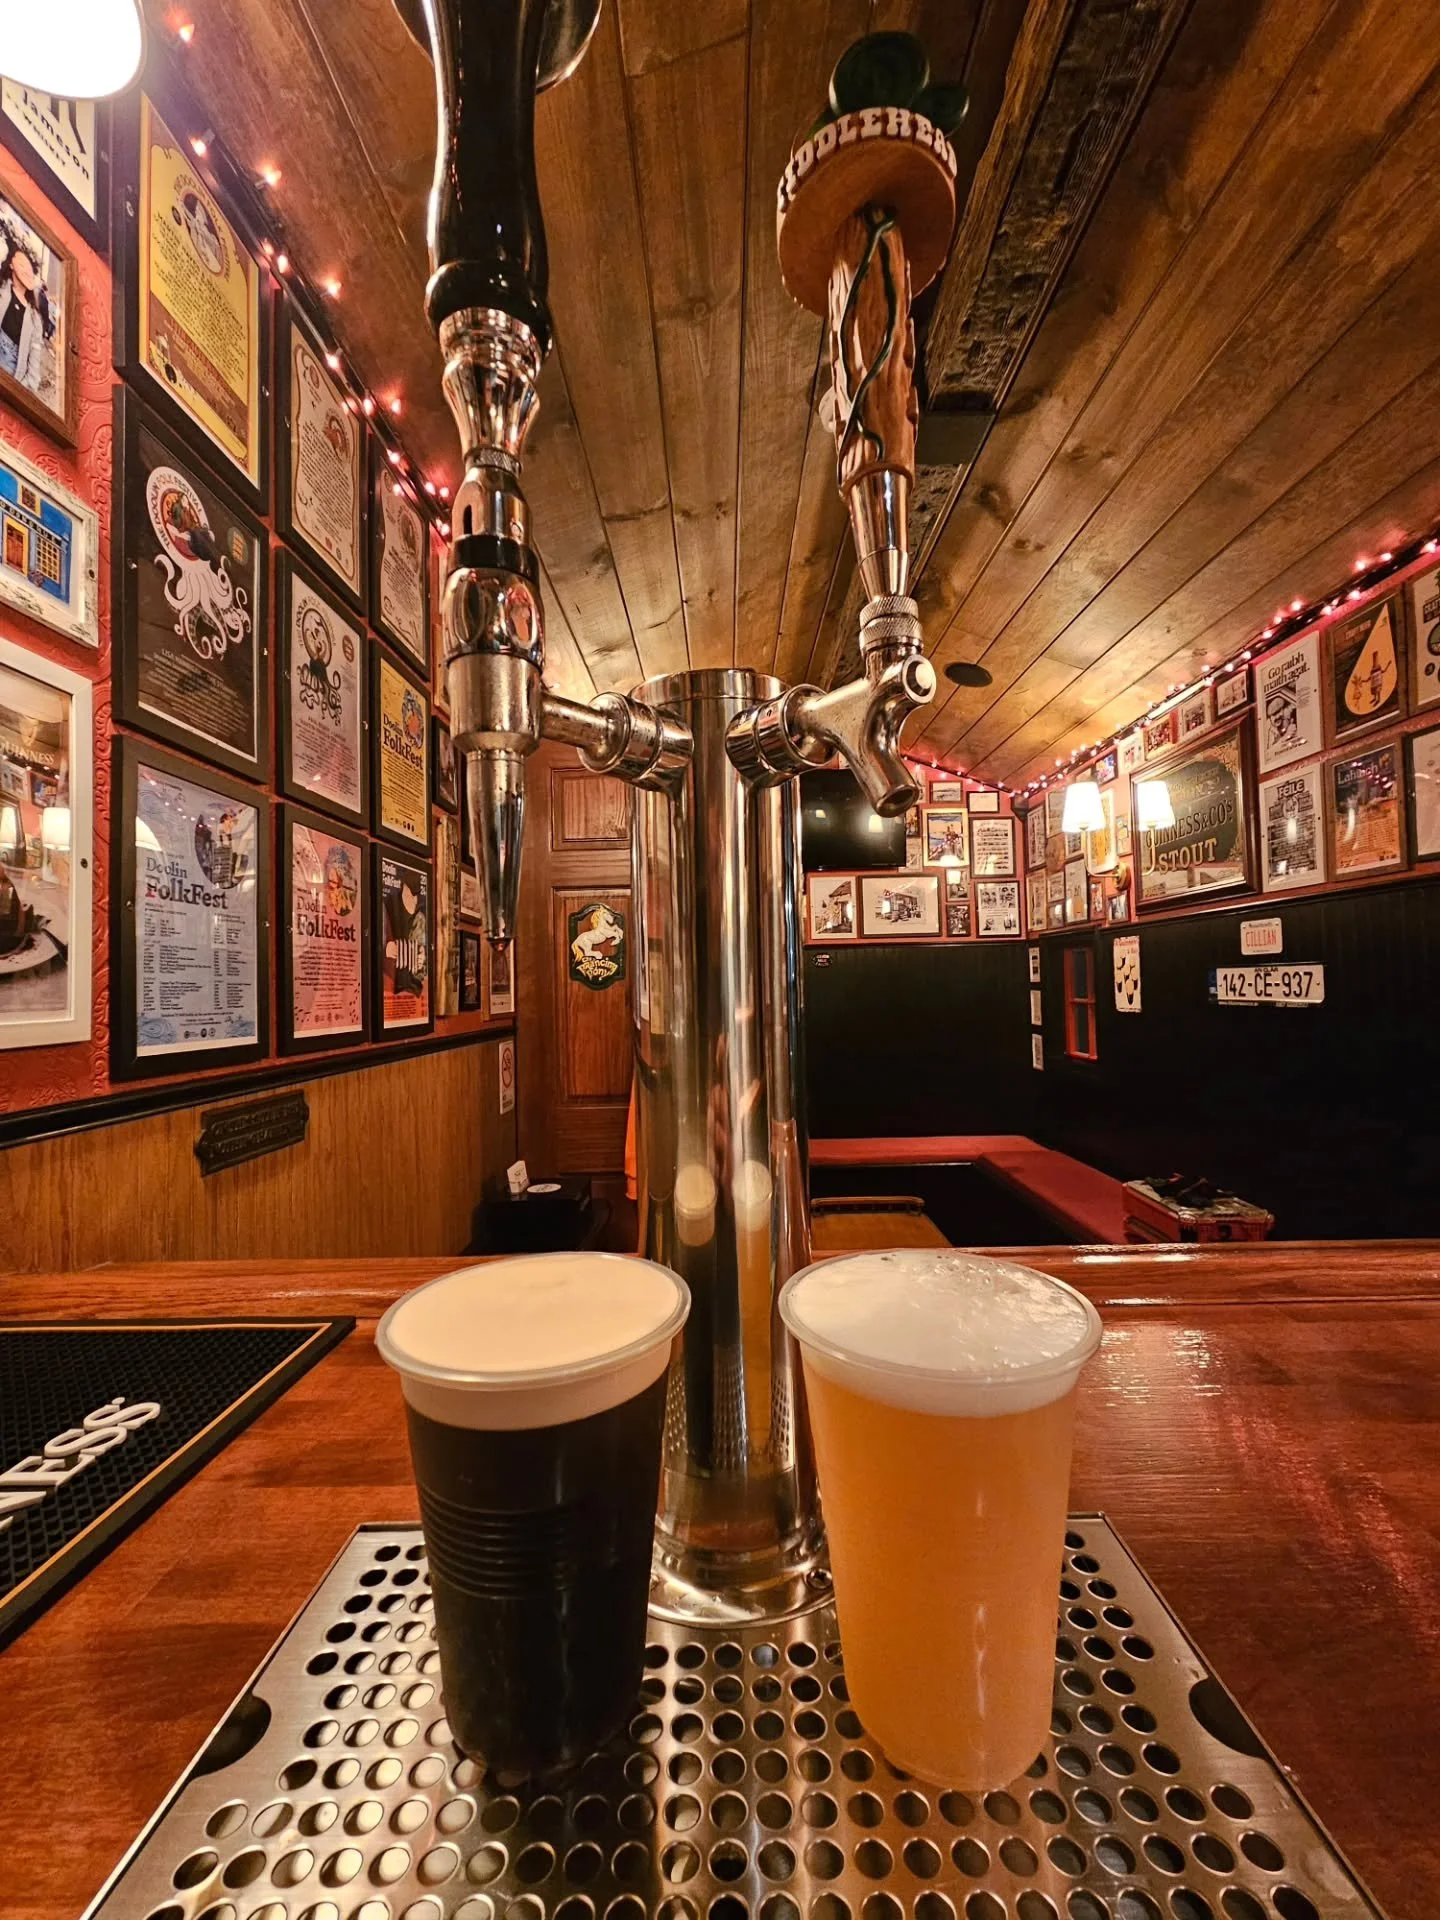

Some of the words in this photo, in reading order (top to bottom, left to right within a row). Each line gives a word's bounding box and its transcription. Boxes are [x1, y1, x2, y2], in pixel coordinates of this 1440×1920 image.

[23, 88, 90, 180] Jameson
[1263, 675, 1288, 693] maith
[1288, 661, 1310, 679] agat.
[1269, 667, 1280, 680] Go
[1281, 651, 1304, 674] raibh
[383, 713, 404, 737] Doolin
[383, 726, 423, 770] FolkFest
[146, 857, 188, 880] Doolin
[382, 861, 397, 876] Doolin
[1158, 837, 1217, 875] STOUT
[145, 874, 229, 910] FolkFest
[297, 895, 327, 914] Doolin
[297, 913, 356, 942] FolkFest
[1223, 972, 1313, 998] 142-CE-937
